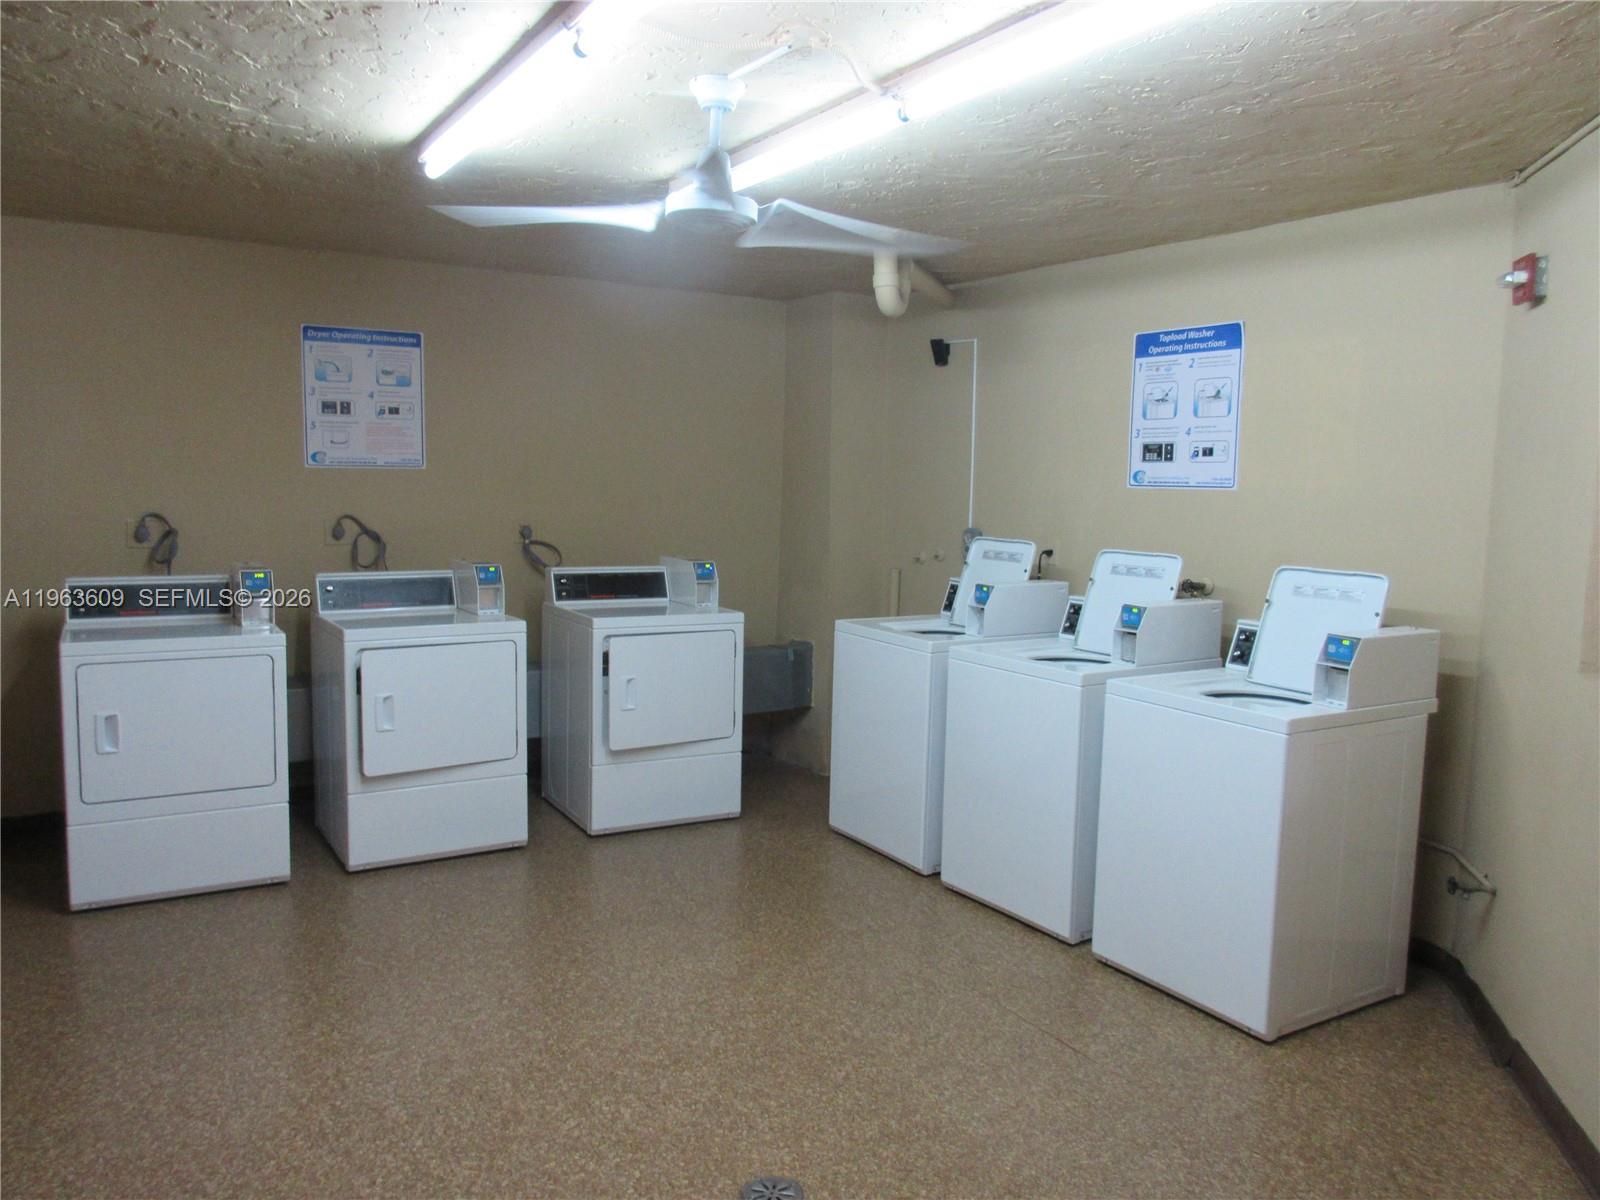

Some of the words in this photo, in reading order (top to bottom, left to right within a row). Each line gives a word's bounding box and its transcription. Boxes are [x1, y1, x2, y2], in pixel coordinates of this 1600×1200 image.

[307, 329, 329, 340] Dryer
[331, 330, 371, 342] Operating
[372, 333, 417, 344] Instructions
[1159, 331, 1187, 343] Topload
[1187, 329, 1215, 339] Washer
[1148, 343, 1183, 355] Operating
[1184, 339, 1227, 351] Instructions
[367, 349, 374, 358] 2
[1188, 358, 1196, 369] 2
[368, 391, 374, 400] 4
[310, 421, 316, 430] 5
[1134, 428, 1141, 439] 3
[1184, 427, 1192, 437] 4
